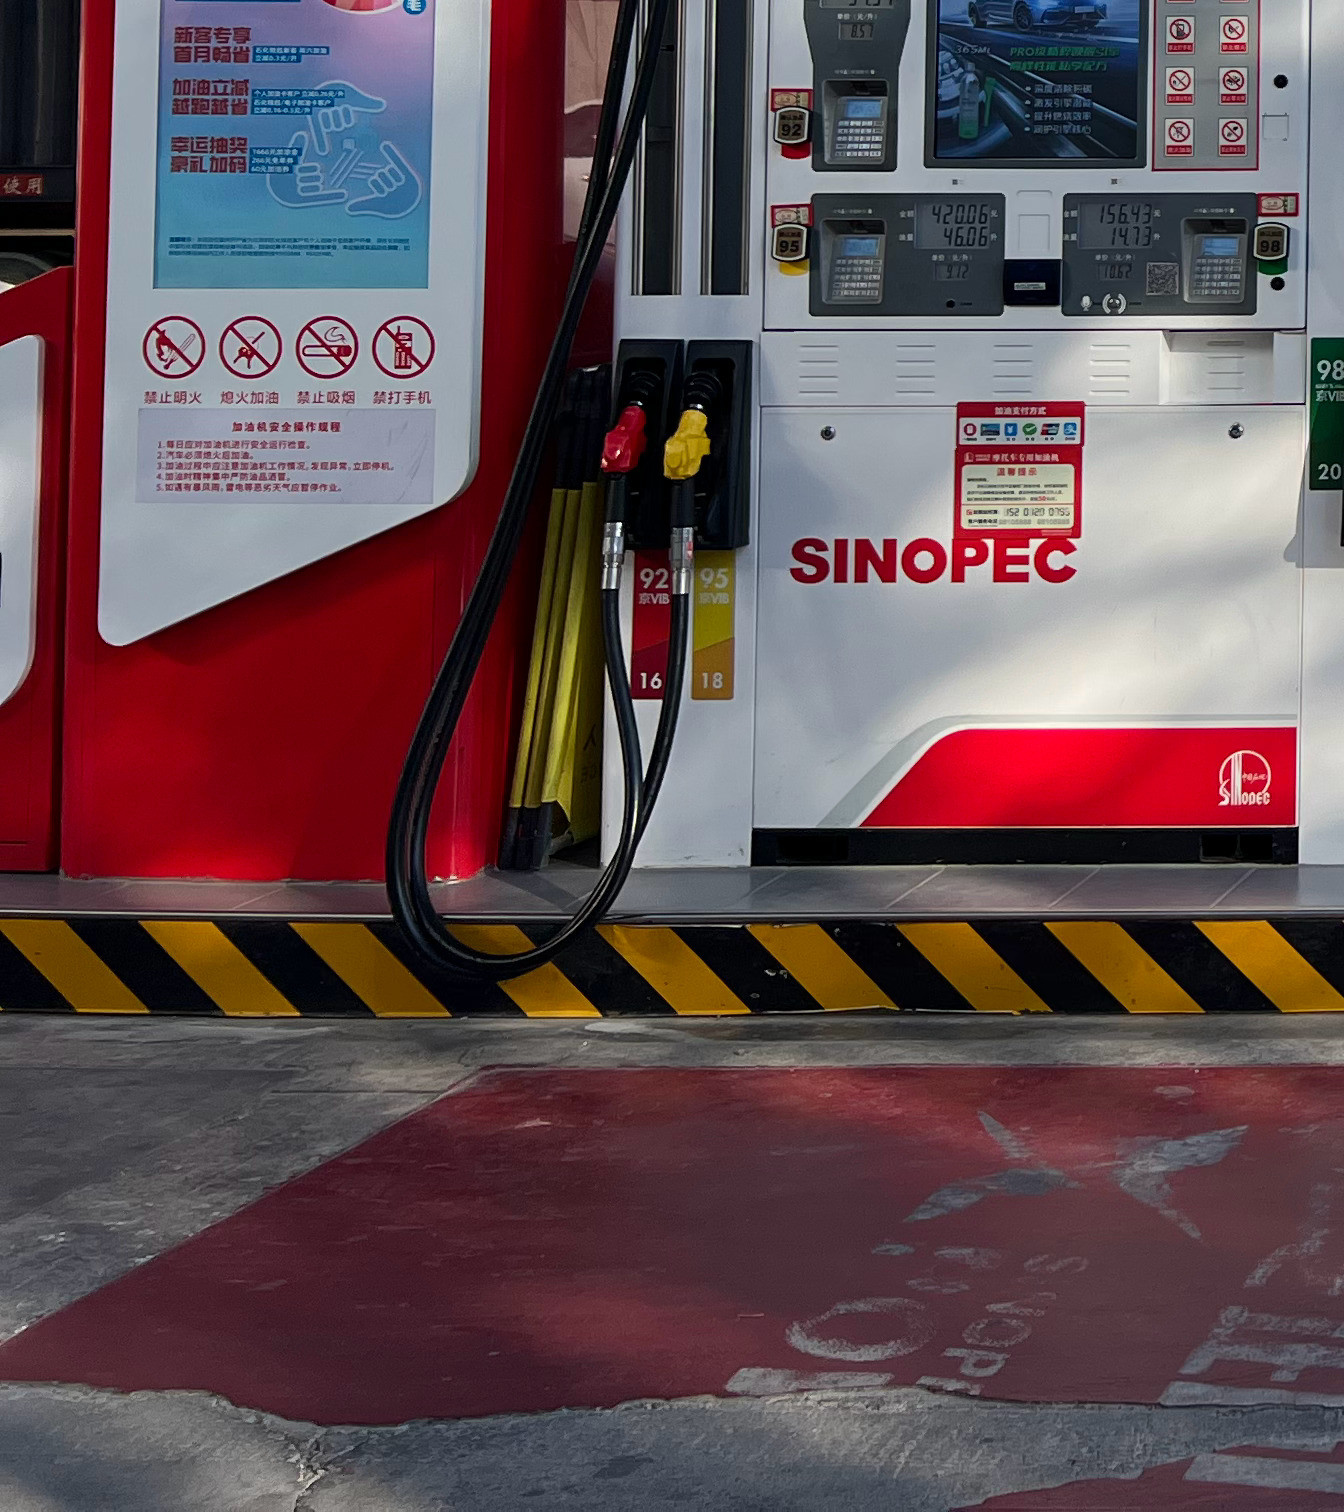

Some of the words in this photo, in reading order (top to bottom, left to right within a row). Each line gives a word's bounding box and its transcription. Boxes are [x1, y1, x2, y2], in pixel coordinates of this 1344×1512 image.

[173, 26, 252, 45] 新客专享
[850, 23, 874, 39] 8.57
[172, 78, 250, 97] 加油立减
[781, 123, 803, 137] 92
[170, 136, 248, 154] 幸运抽奖
[931, 203, 989, 225] 420.06
[1099, 203, 1153, 225] 156.43
[943, 226, 989, 247] 46.06
[1110, 225, 1152, 247] 14.73
[779, 240, 800, 254] 95
[1259, 239, 1282, 254] 98
[143, 390, 202, 405] 禁止明火
[219, 390, 280, 405] 熄火加油
[296, 390, 356, 405] 禁止吸烟
[372, 390, 432, 405] 禁打手机
[1317, 462, 1342, 481] 20
[789, 536, 1079, 584] SINOPEC
[639, 567, 670, 589] 92
[700, 567, 730, 589] 95
[639, 672, 663, 690] 16
[702, 672, 724, 690] 18
